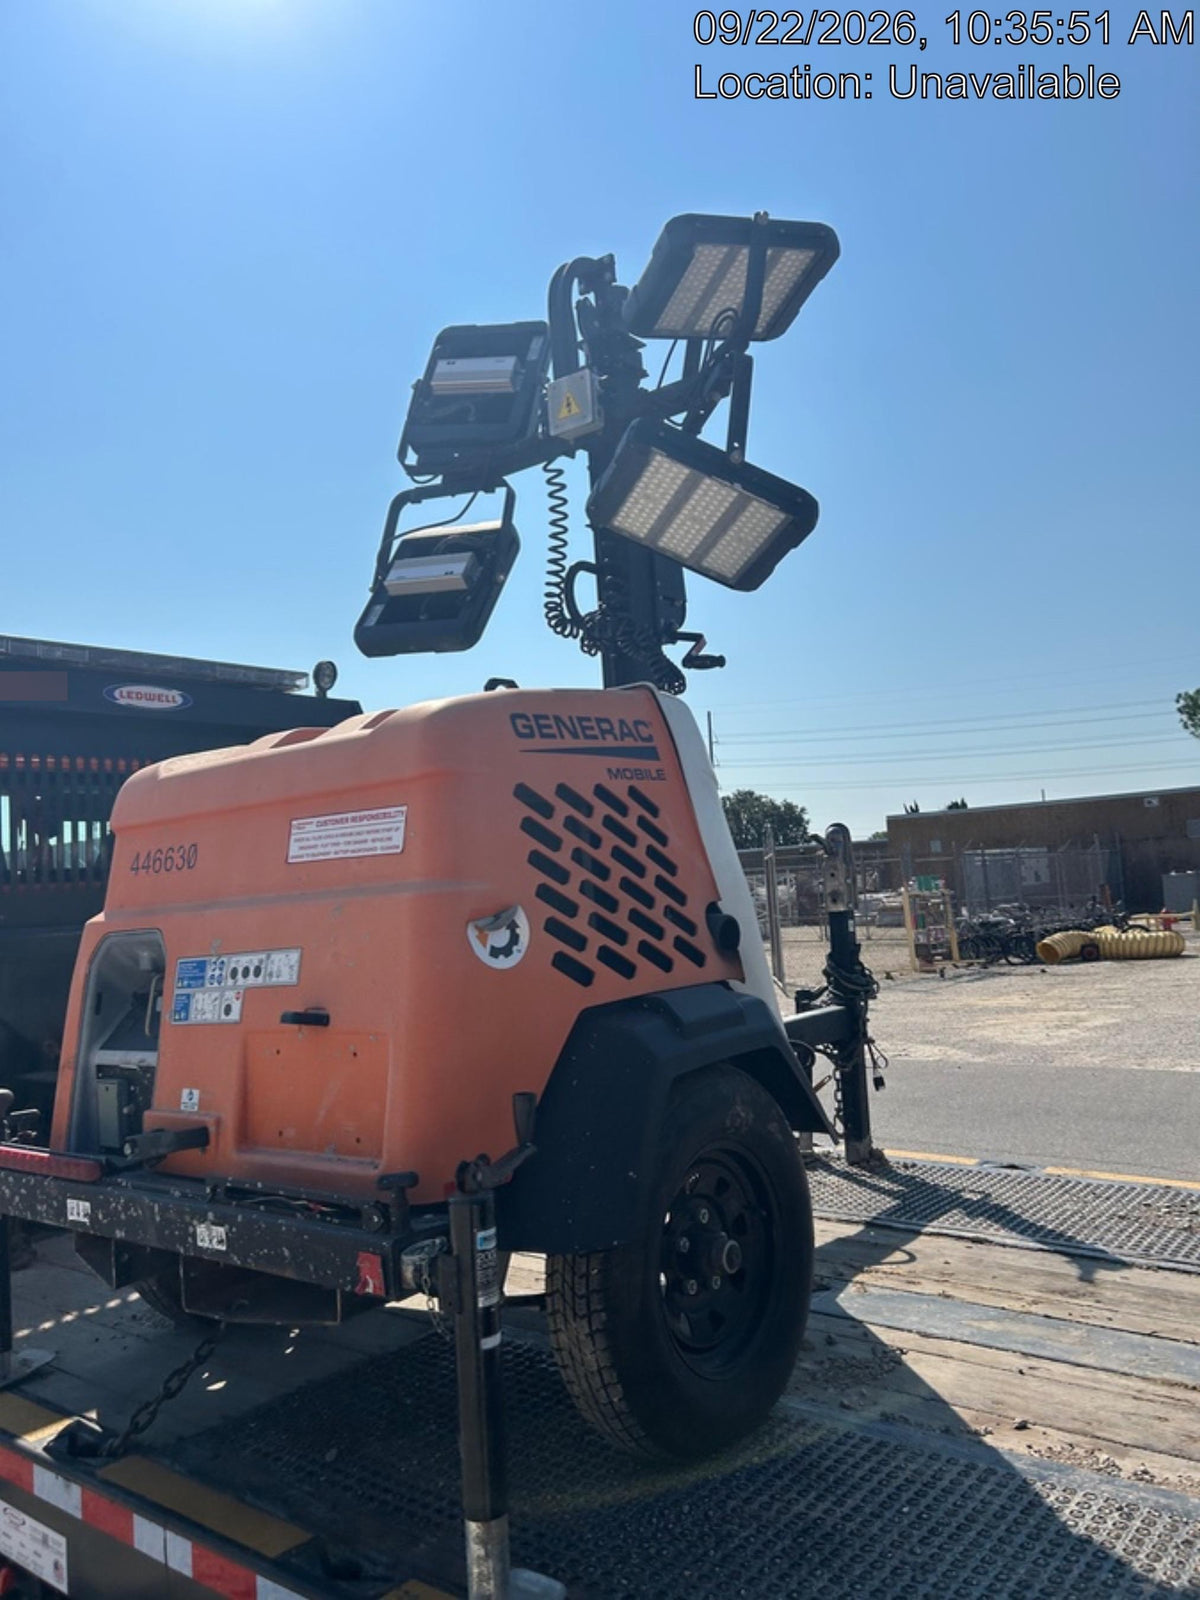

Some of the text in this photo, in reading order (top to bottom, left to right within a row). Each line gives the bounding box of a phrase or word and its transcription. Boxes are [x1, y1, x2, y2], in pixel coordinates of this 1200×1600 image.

[119, 689, 178, 704] LEDWELL
[509, 712, 655, 743] GENERAC
[606, 767, 667, 781] MOBILE
[315, 816, 349, 828] CUSTOMER
[130, 842, 199, 876] 446630
